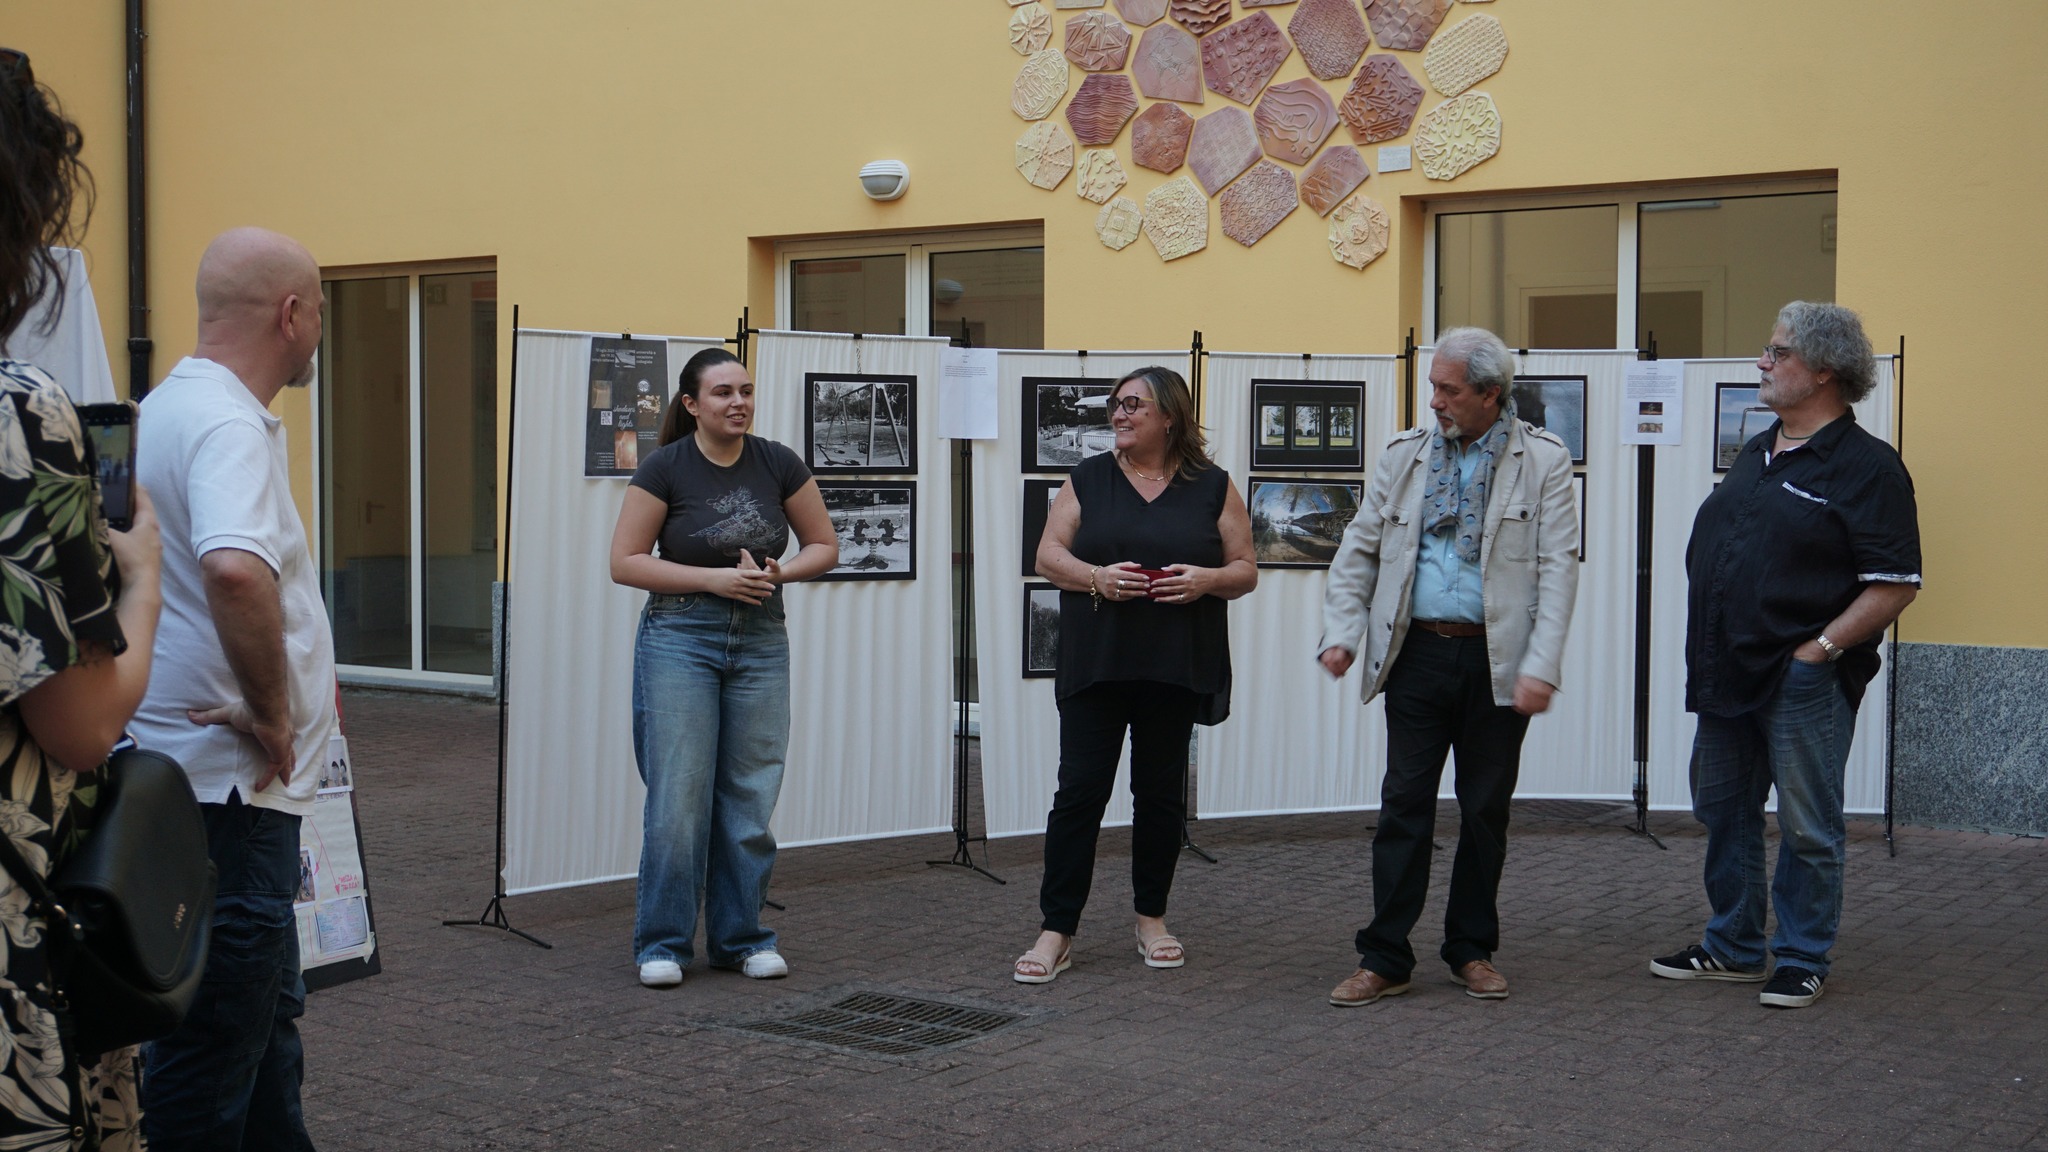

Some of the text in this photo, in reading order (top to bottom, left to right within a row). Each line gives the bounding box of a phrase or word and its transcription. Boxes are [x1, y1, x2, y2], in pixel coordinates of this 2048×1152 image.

[612, 404, 636, 413] shadows
[618, 412, 631, 420] and
[617, 420, 634, 431] lights
